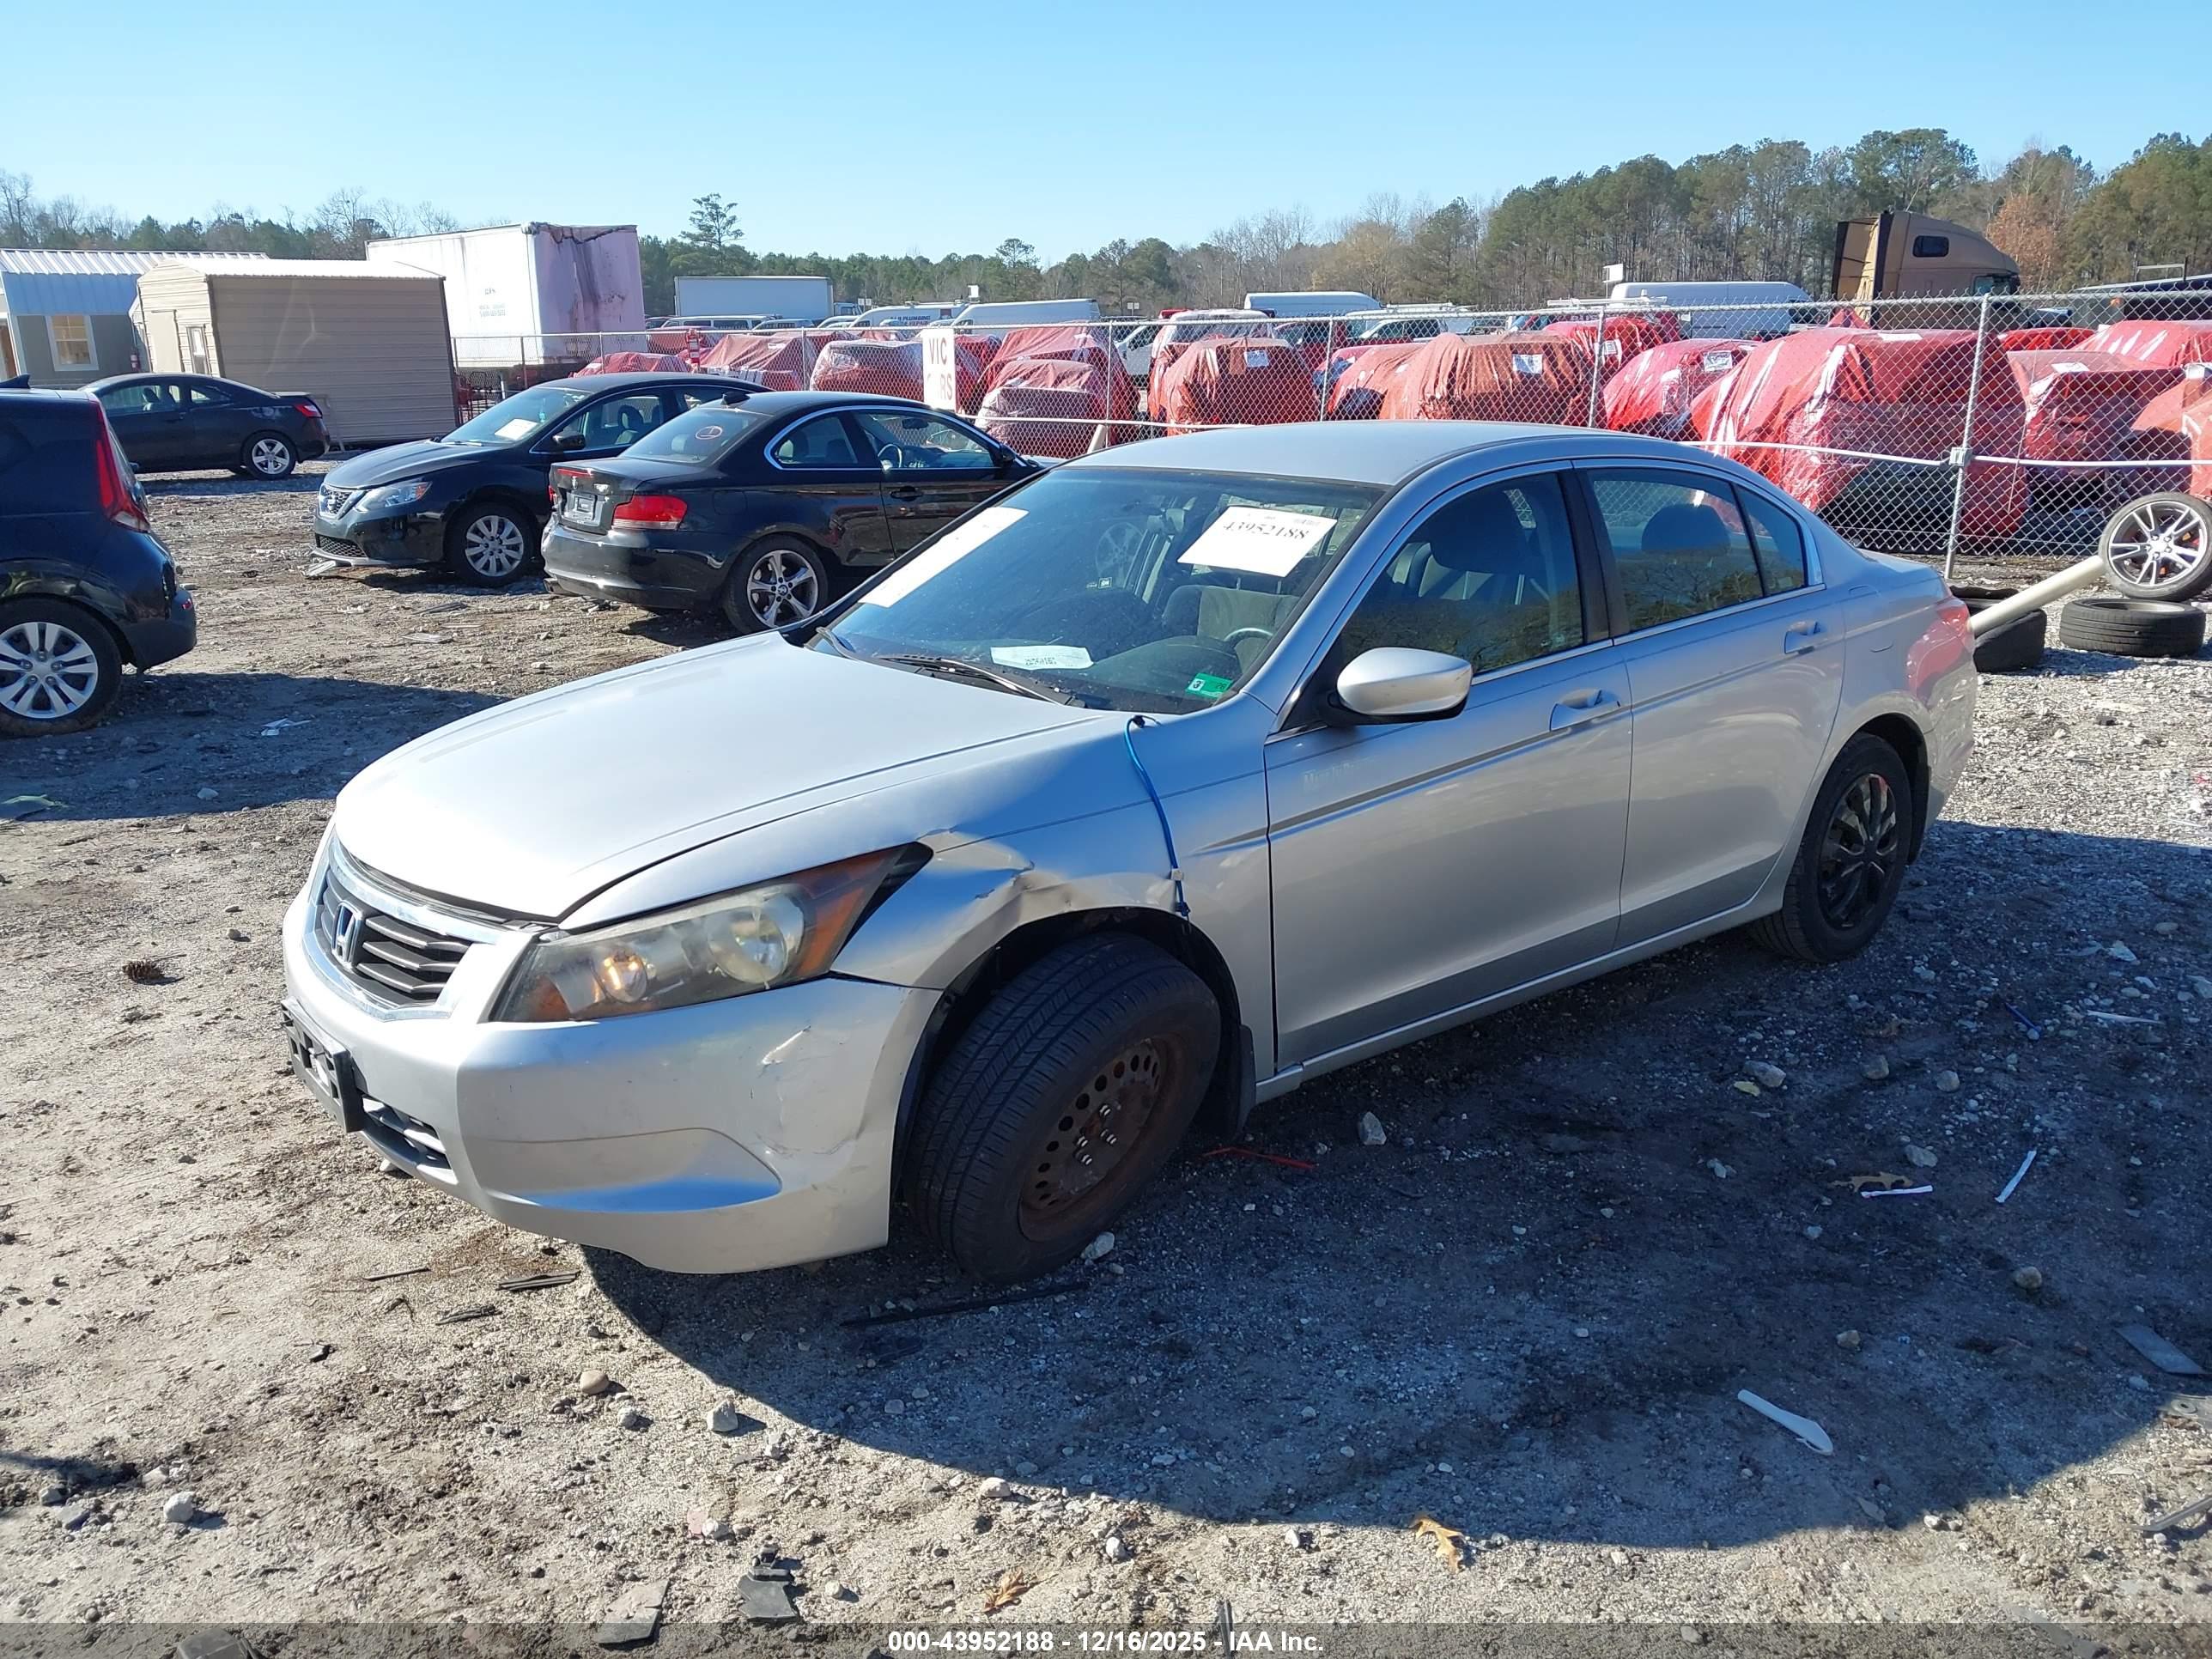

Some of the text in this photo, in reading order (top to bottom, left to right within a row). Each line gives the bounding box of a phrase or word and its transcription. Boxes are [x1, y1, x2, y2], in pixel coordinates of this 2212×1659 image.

[928, 337, 947, 365] VIC
[1224, 521, 1309, 539] 43952188
[1193, 680, 1202, 689] 3
